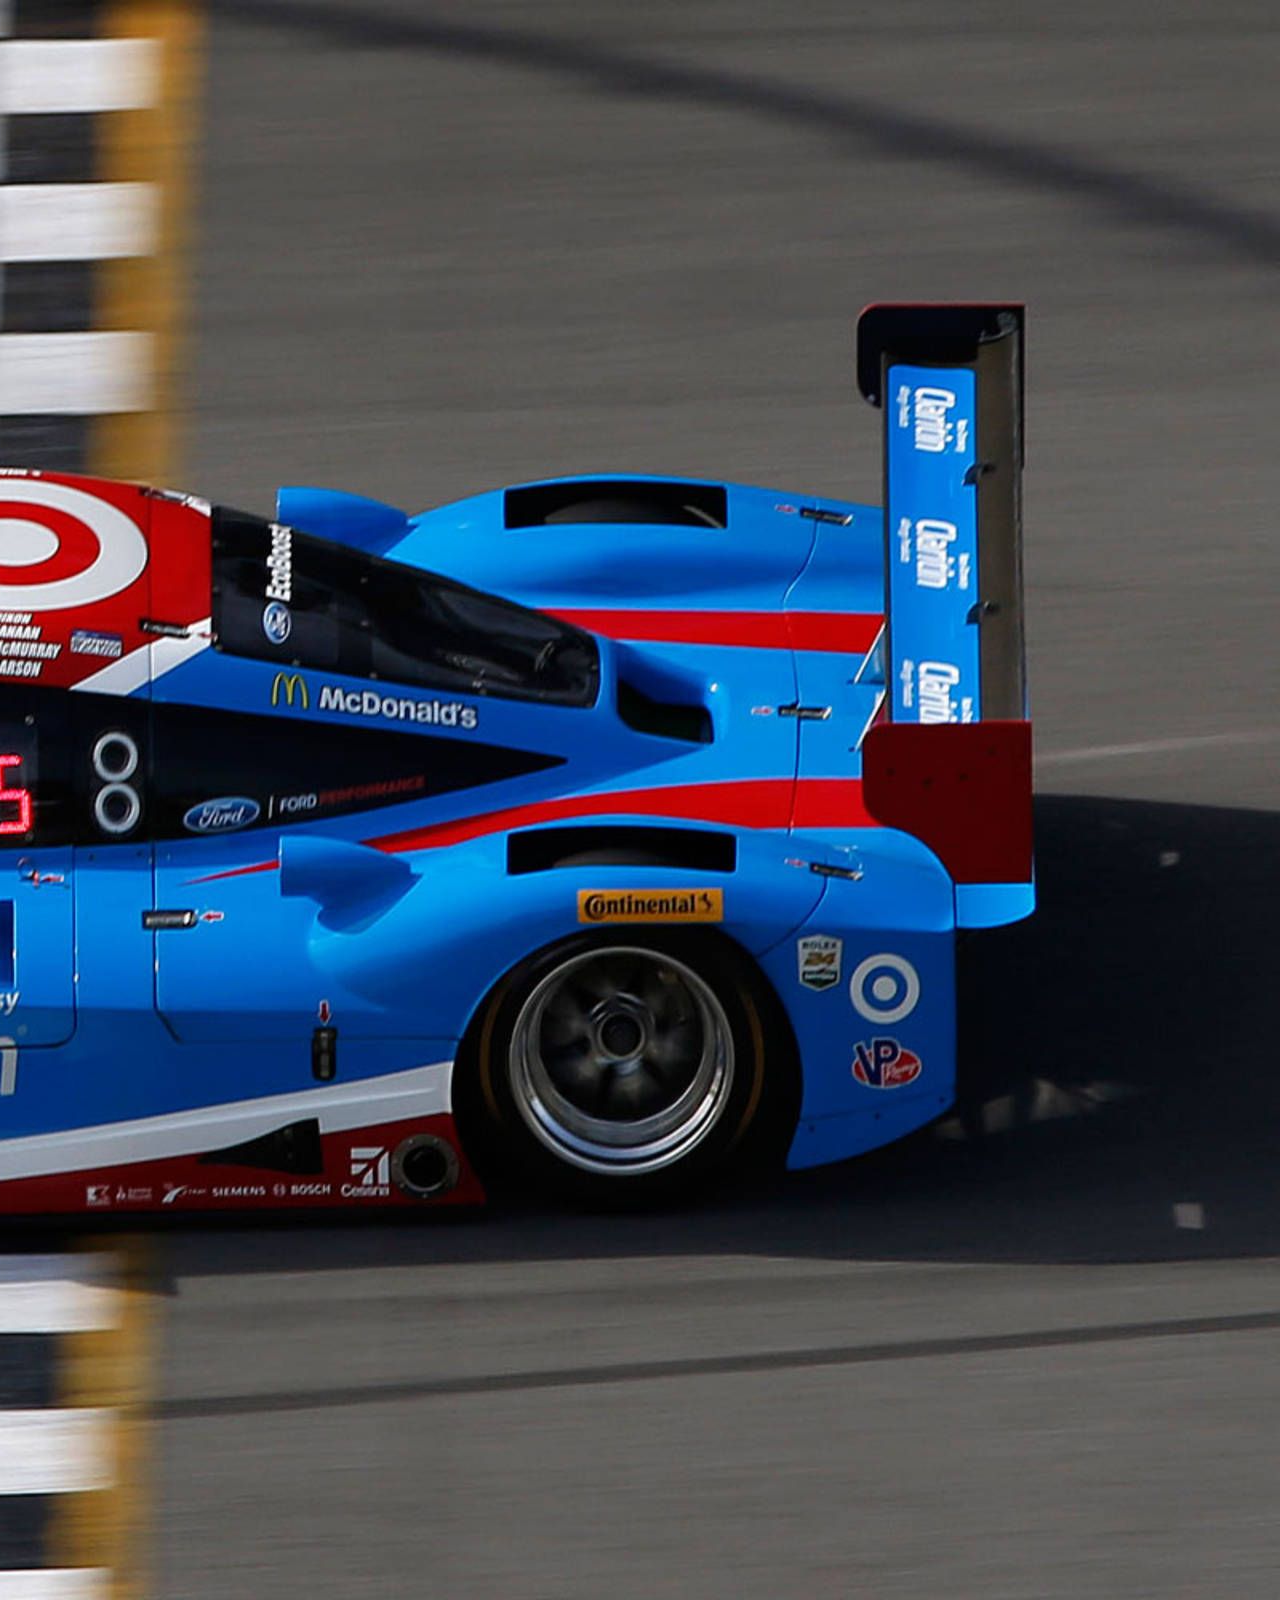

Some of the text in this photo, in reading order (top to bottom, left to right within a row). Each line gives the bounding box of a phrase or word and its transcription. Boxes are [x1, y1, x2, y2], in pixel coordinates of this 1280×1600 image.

[266, 524, 291, 602] EcoBoost
[319, 688, 478, 729] McDonald's
[919, 661, 959, 724] Clariti
[280, 775, 425, 813] FORD PERFORMANCE
[584, 892, 696, 920] Continental
[855, 1039, 900, 1087] VP
[211, 1185, 266, 1197] SIEMENS
[290, 1184, 331, 1195] BOSCH
